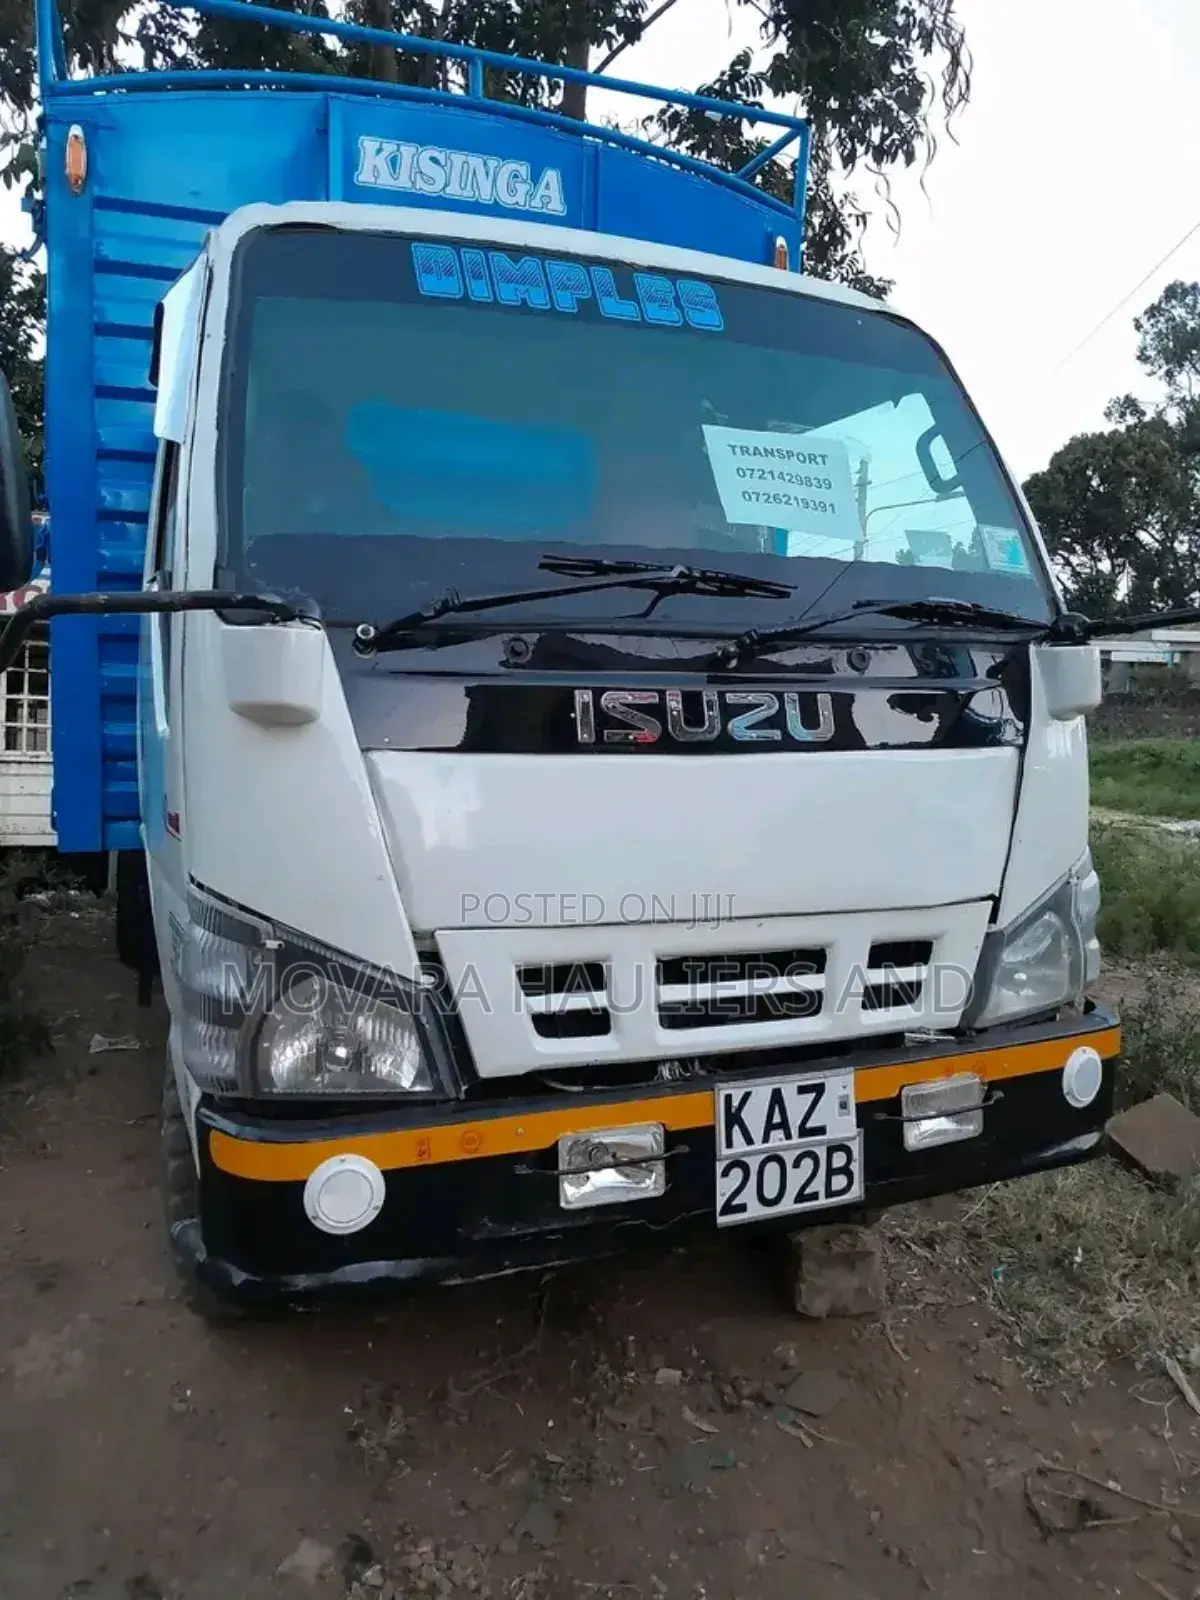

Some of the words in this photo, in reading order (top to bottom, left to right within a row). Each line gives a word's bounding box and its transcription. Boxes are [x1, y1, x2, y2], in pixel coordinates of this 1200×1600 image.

[355, 137, 567, 215] KISINGA
[411, 242, 724, 331] DIMPLES
[727, 443, 829, 466] TRANSPORT
[736, 466, 833, 490] 0721429839
[741, 490, 836, 514] 0726219391
[574, 689, 835, 743] ISUZU
[724, 1082, 827, 1149] KAZ
[719, 1143, 855, 1217] 202B
